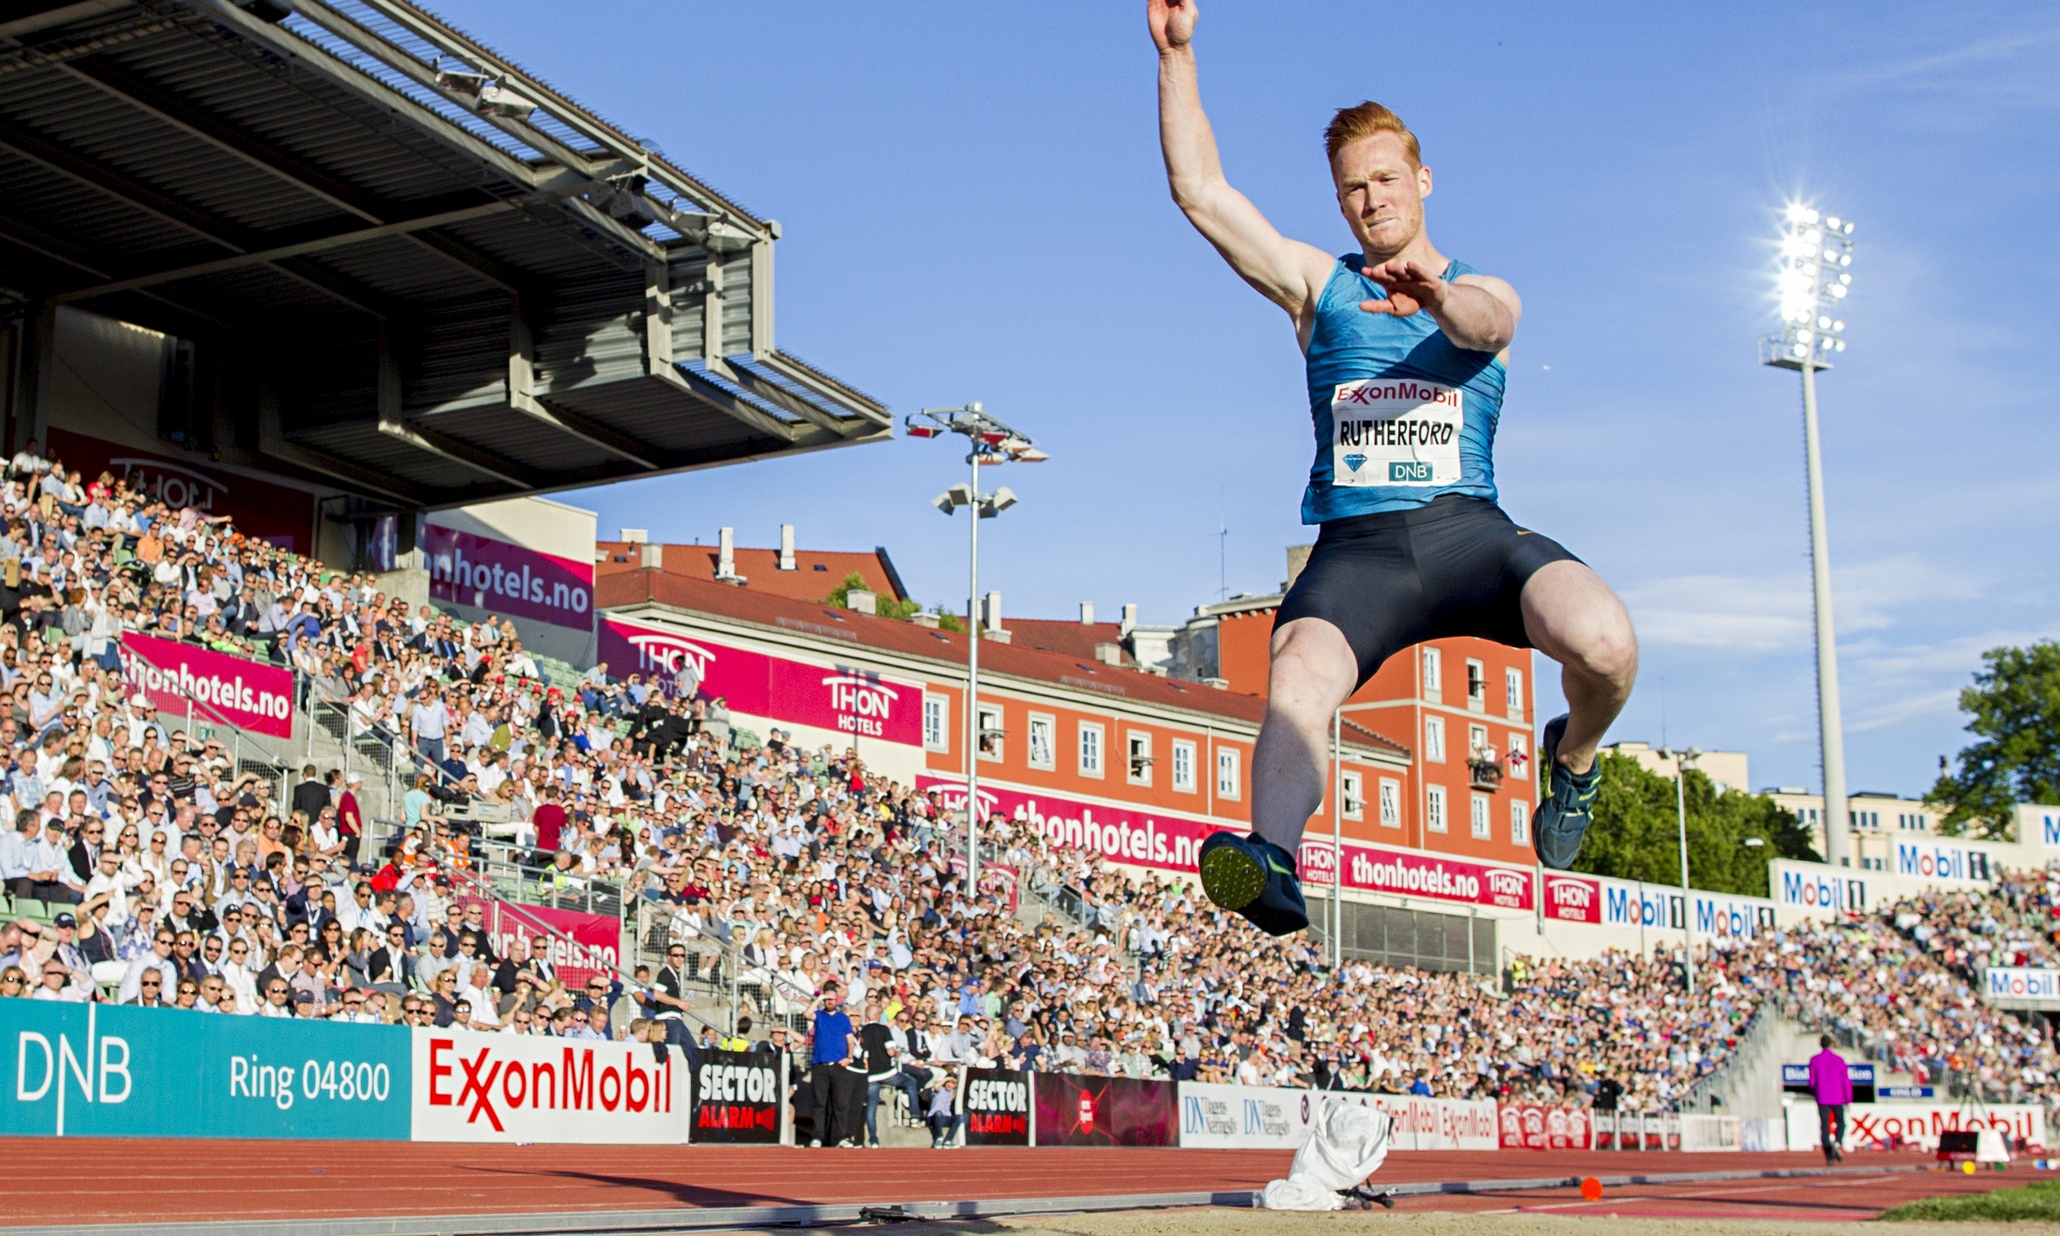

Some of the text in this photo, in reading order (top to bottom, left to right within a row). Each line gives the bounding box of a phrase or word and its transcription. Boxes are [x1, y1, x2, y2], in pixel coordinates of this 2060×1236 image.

[1337, 383, 1457, 407] ExxonMobil
[1340, 419, 1453, 446] RUTHERFORD
[1395, 462, 1428, 482] DNB
[822, 676, 898, 719] THON
[838, 713, 883, 736] HOTELS
[1306, 869, 1334, 883] HOTELS
[1352, 852, 1479, 898] thonhotels.no
[1900, 844, 1962, 879] Mobil
[1485, 869, 1528, 895] THON
[1548, 879, 1595, 908] THON
[1784, 871, 1842, 908] Mobil
[1494, 895, 1519, 907] HOTELS
[1608, 887, 1666, 927] Mobil
[1697, 899, 1754, 936] Mobil
[1992, 973, 2052, 994] Mobil
[17, 1002, 132, 1136] DNB
[230, 1055, 390, 1110] Ring 04800
[429, 1038, 671, 1132] ExxonMobil
[699, 1063, 776, 1103] SECTOR
[967, 1079, 1027, 1112] SECTOR
[698, 1105, 754, 1129] ALARM
[970, 1113, 1012, 1133] ALARM
[1830, 1110, 2034, 1142] xxonMobil
